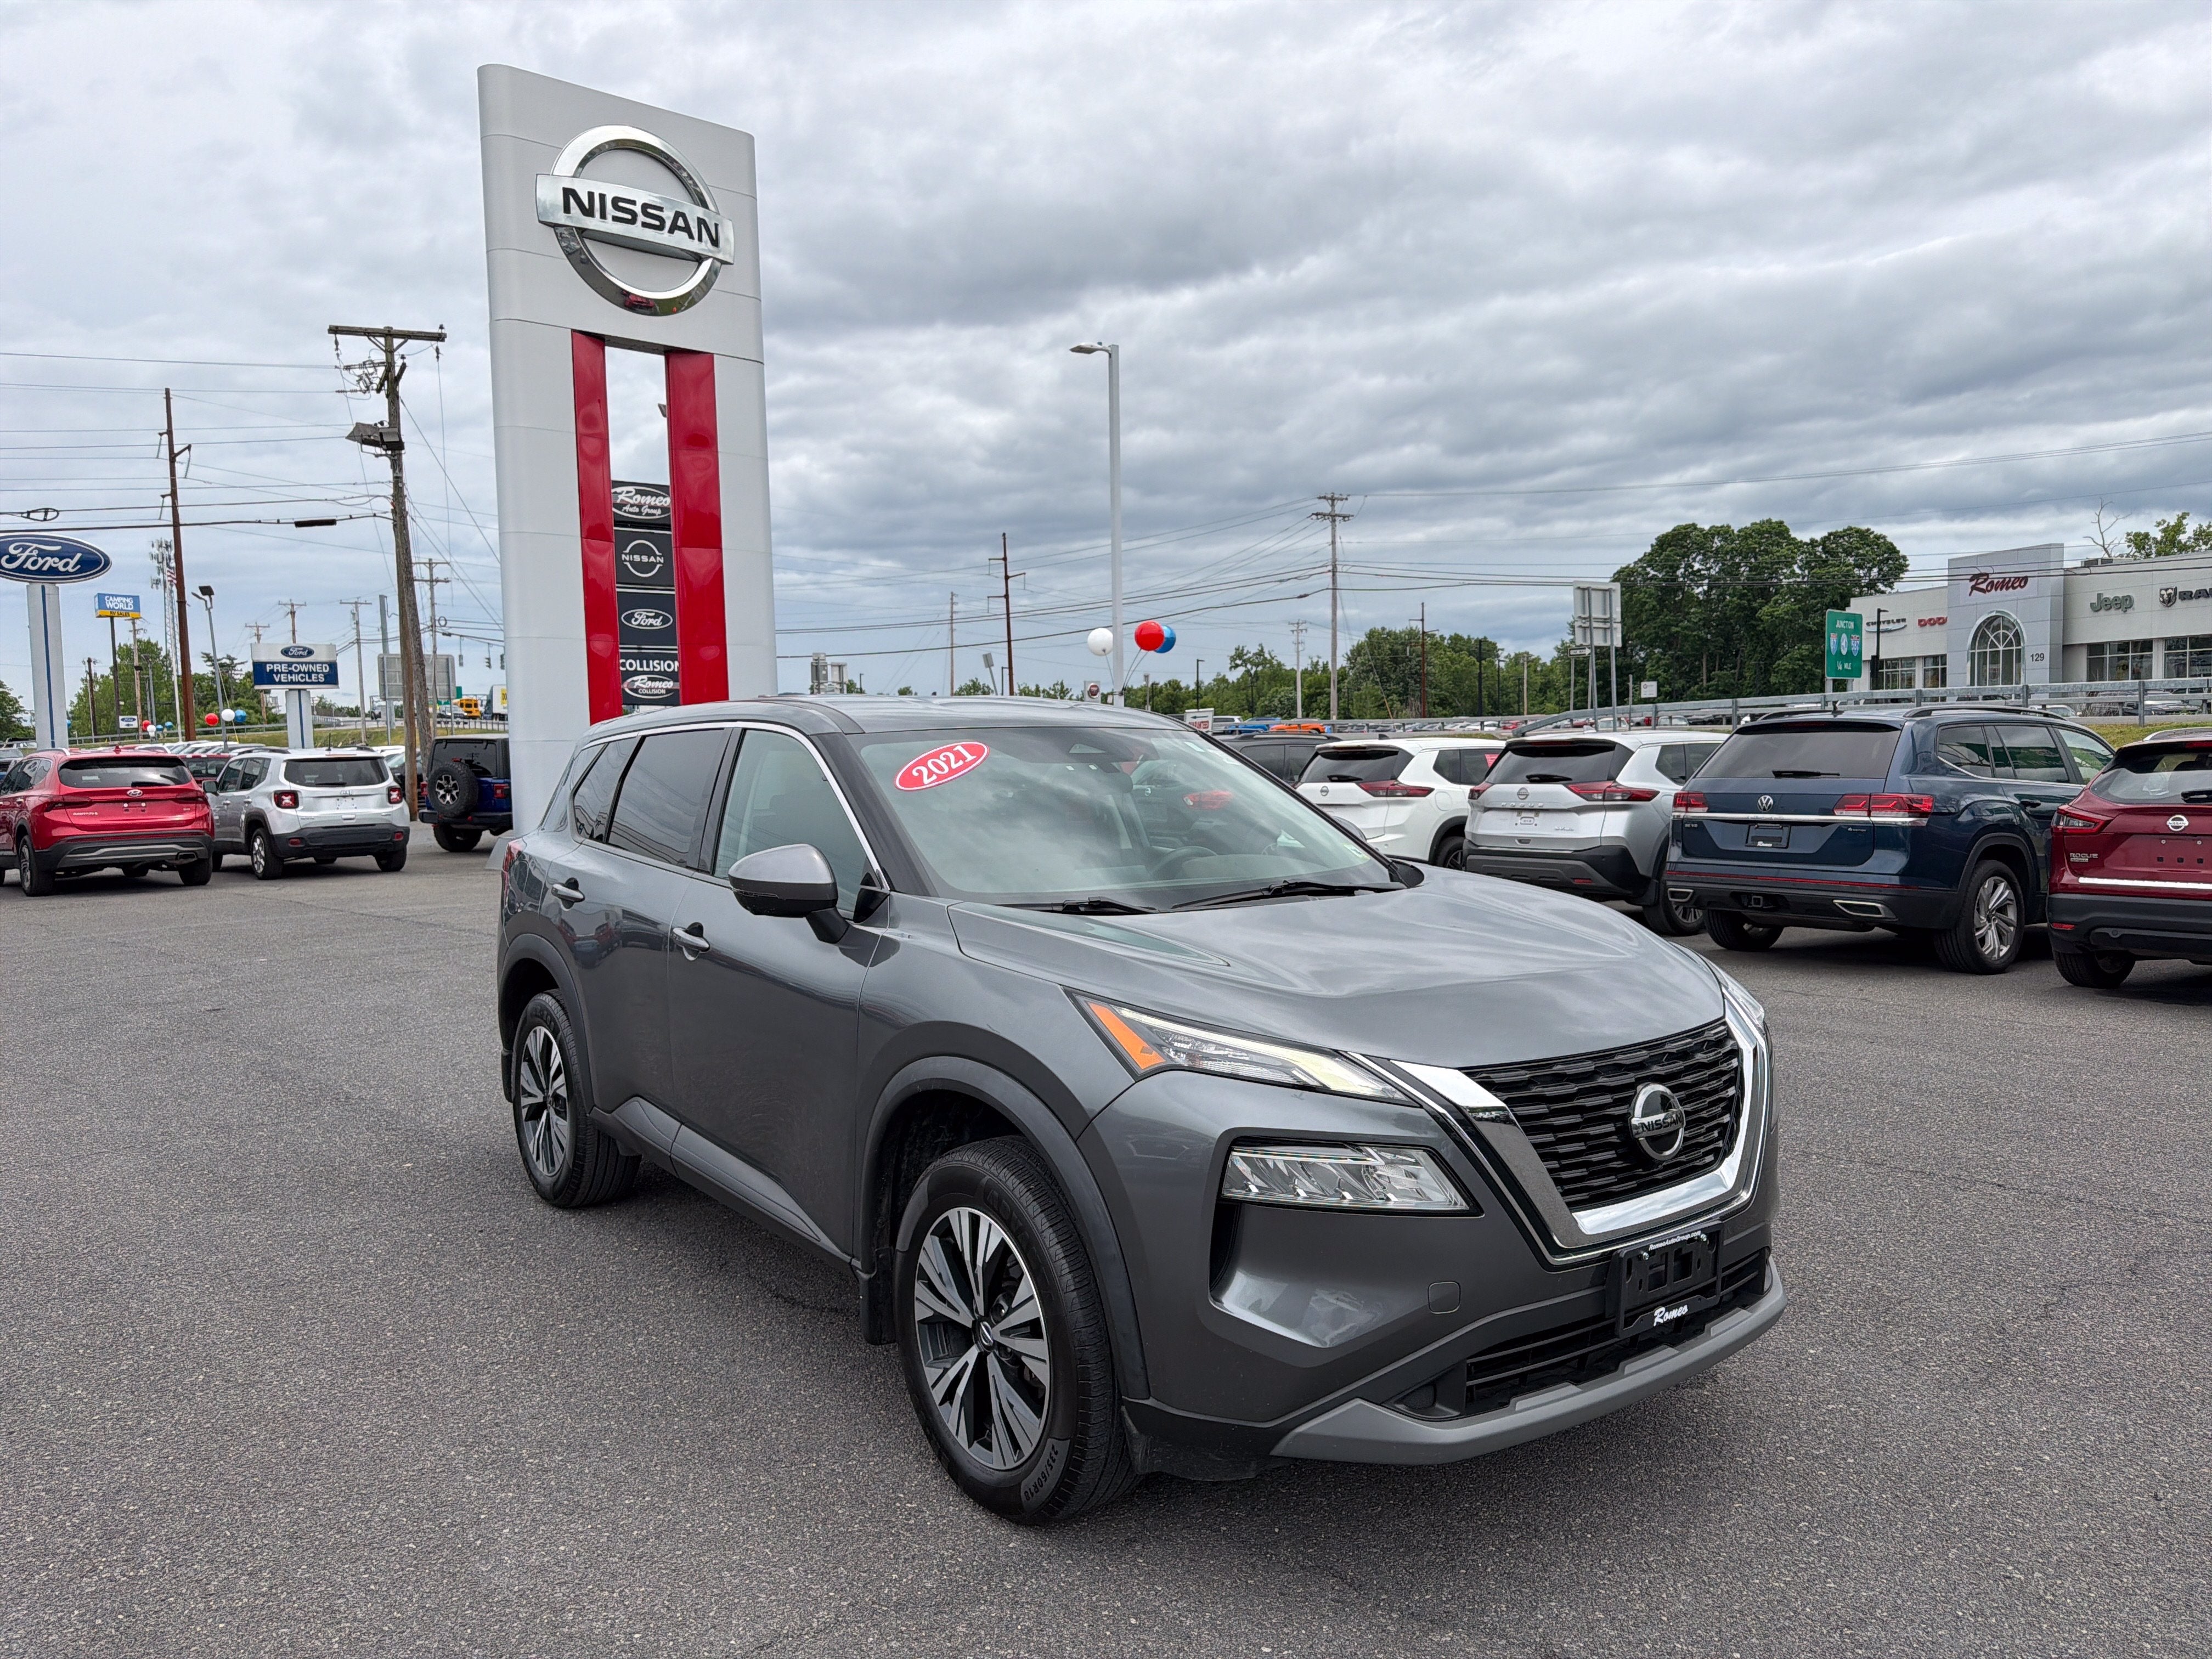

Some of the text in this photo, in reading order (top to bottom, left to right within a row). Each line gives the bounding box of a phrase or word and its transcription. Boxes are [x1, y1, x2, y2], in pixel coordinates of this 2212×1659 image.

[562, 187, 719, 249] NISSAN
[617, 488, 671, 506] Romeo
[622, 504, 662, 516] Auto Group
[1, 542, 82, 573] Ford
[622, 554, 664, 563] NISSAN
[1968, 572, 2029, 596] Romeo
[105, 596, 133, 604] CAMPING
[2179, 588, 2212, 601] RA
[105, 601, 134, 610] WORLD
[2090, 592, 2134, 613] Jeep
[631, 611, 663, 626] Ford
[1836, 620, 1854, 629] JUNCTION
[1866, 618, 1906, 627] CHYSLER
[1917, 617, 1948, 627] DOD
[288, 647, 308, 656] Ford
[2030, 652, 2045, 662] 129
[266, 663, 329, 673] PRE-OWNED
[273, 673, 325, 682] VEHICLES
[633, 675, 674, 689] Romeo
[912, 745, 977, 785] 2021
[1641, 1113, 1683, 1132] NISSAN
[1649, 1231, 1701, 1251] RomeoAutoGroup.com
[1653, 1305, 1689, 1327] Romeo
[1024, 1443, 1059, 1502] 235/60R18
